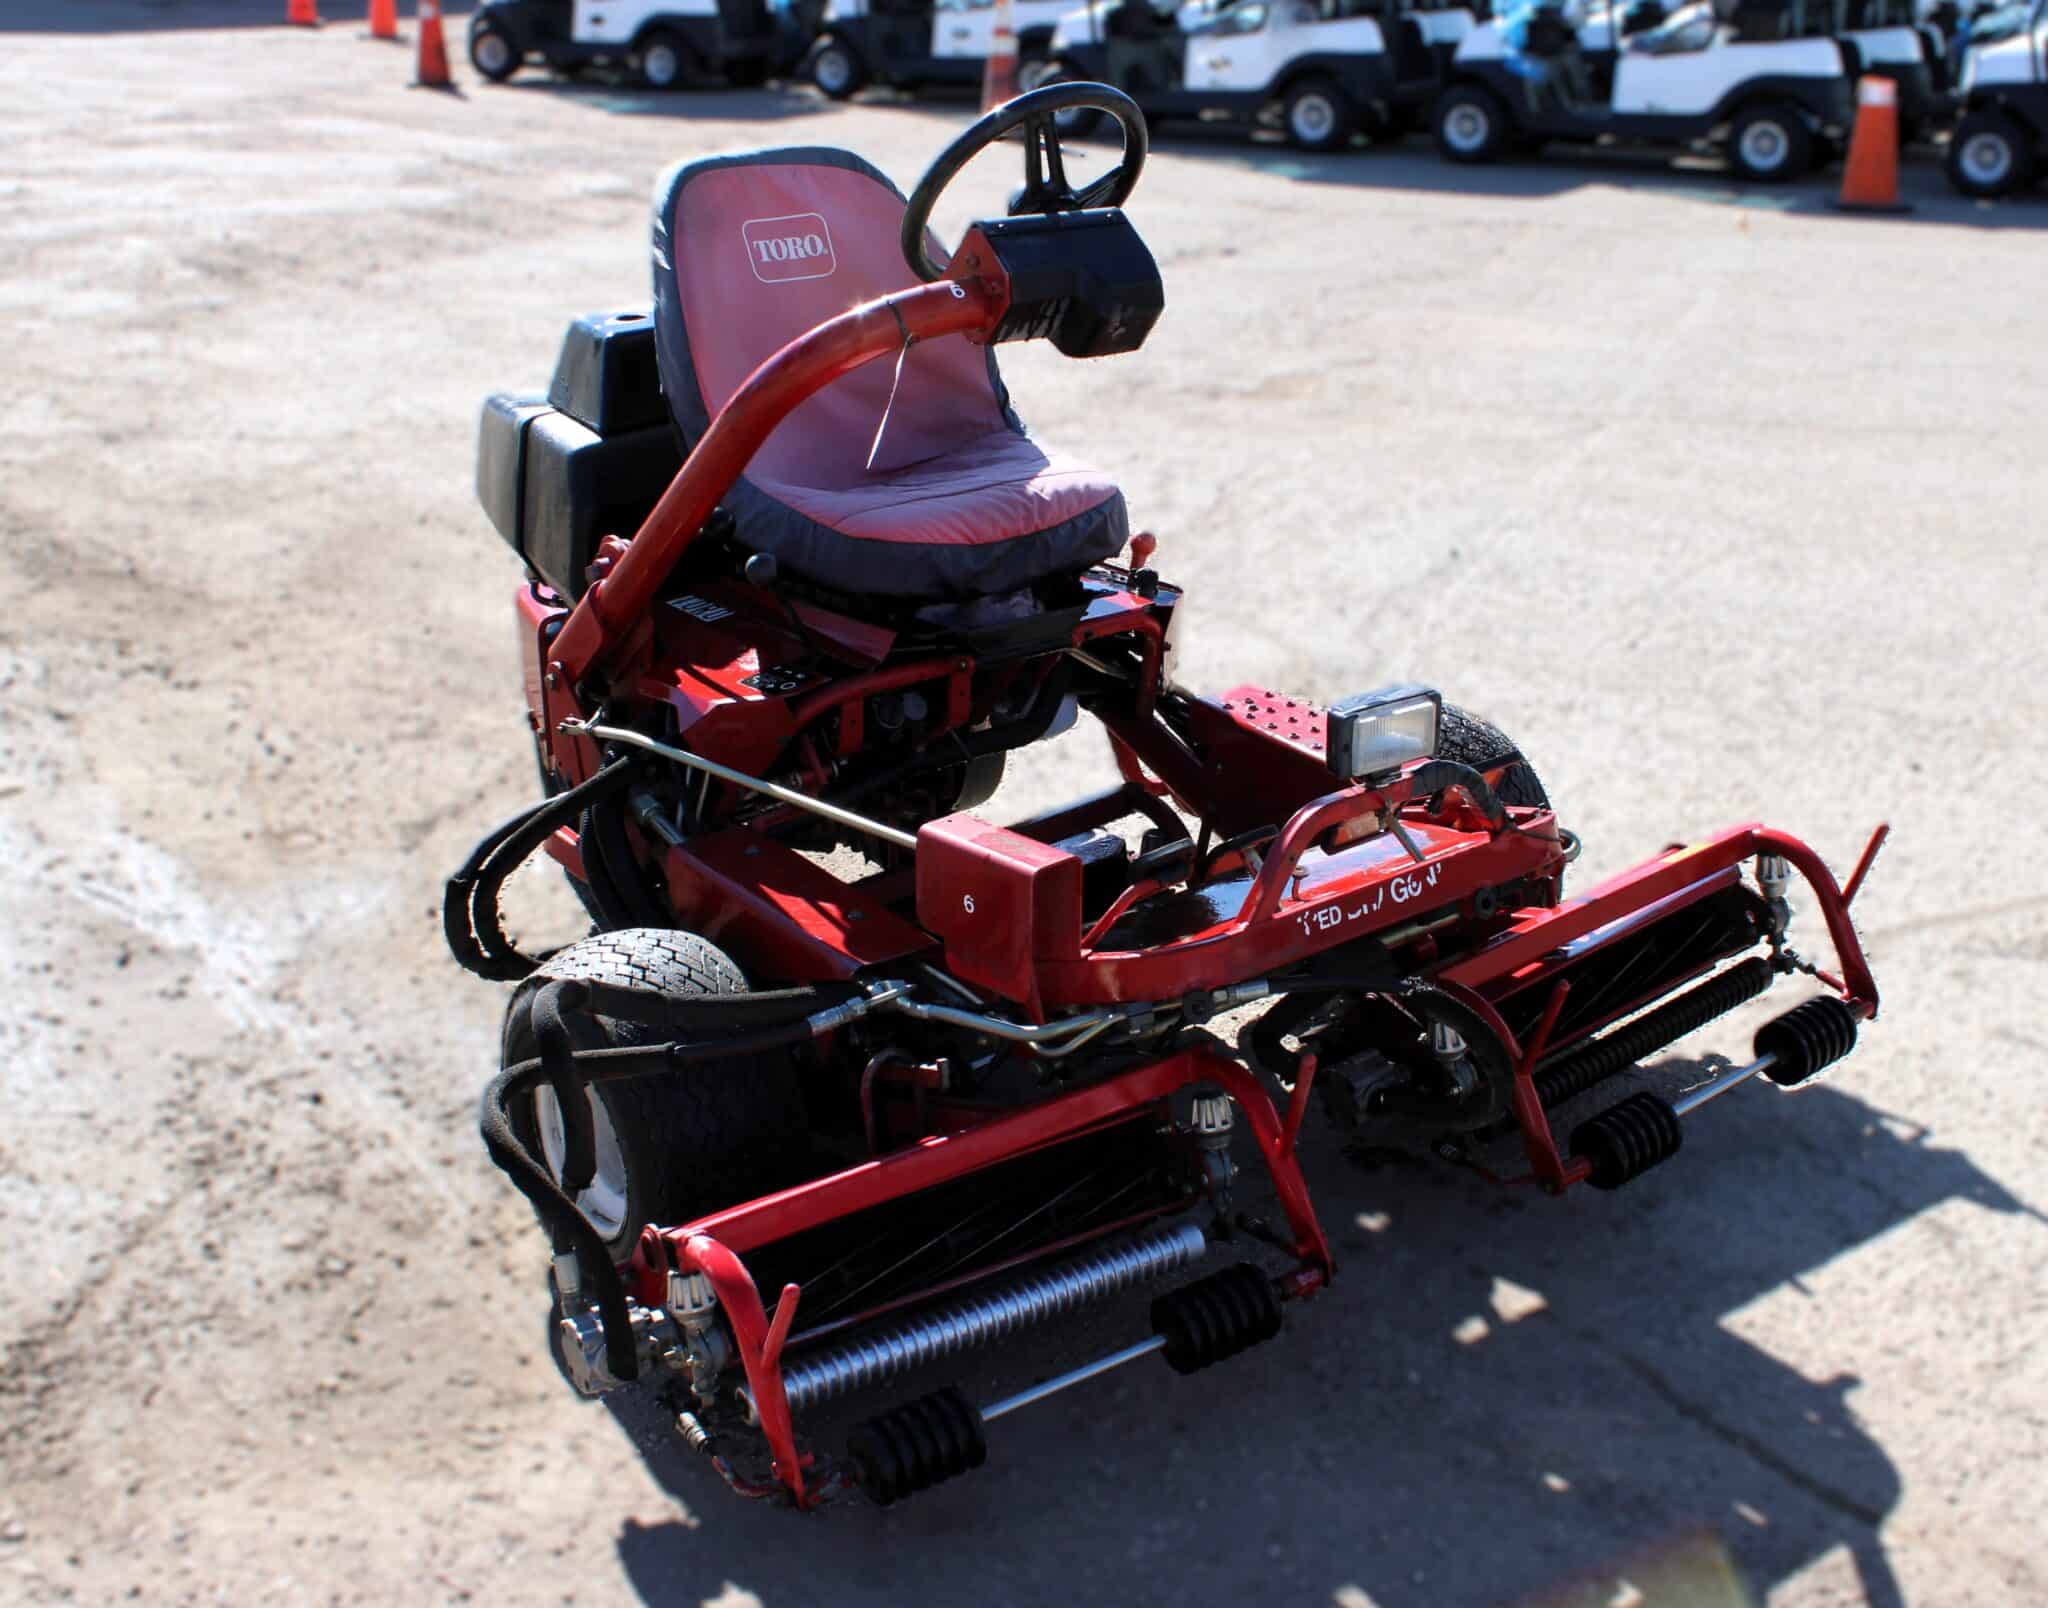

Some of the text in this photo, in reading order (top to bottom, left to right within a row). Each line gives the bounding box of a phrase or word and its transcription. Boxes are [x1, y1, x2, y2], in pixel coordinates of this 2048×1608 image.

[752, 234, 827, 262] TORO
[950, 284, 966, 299] 6
[963, 894, 975, 914] 6
